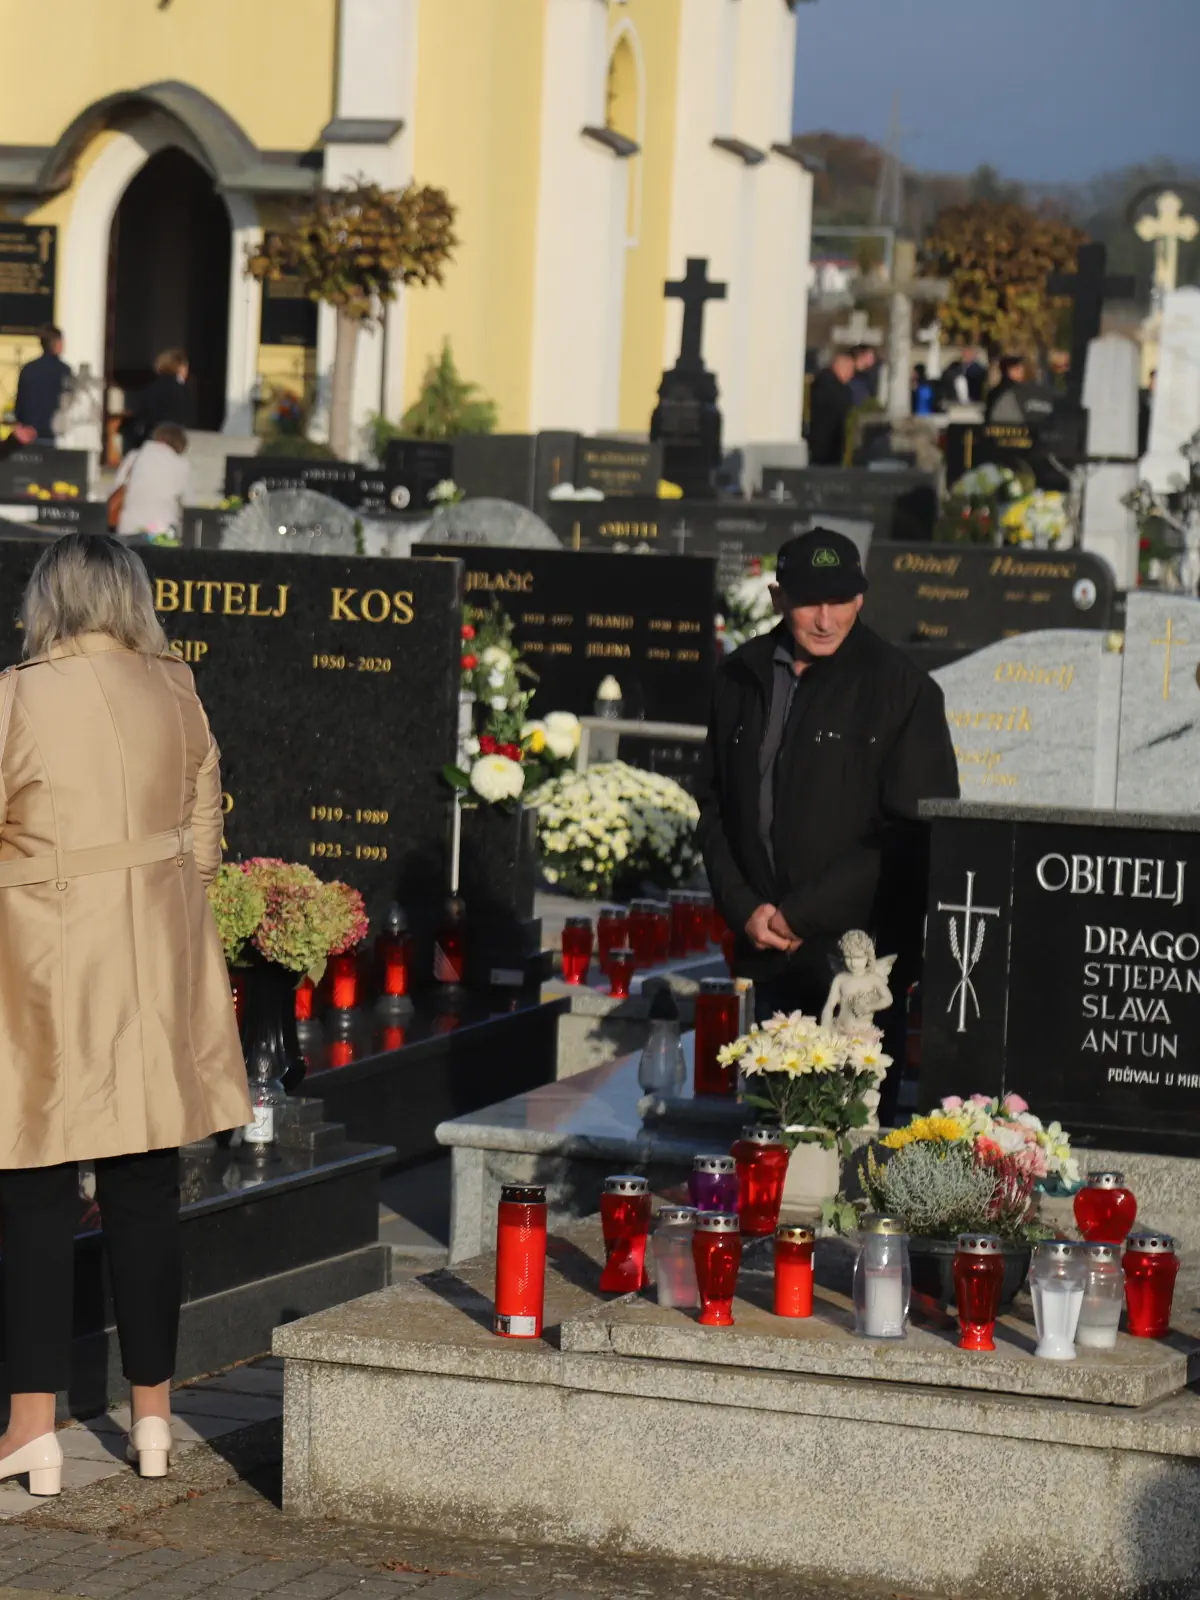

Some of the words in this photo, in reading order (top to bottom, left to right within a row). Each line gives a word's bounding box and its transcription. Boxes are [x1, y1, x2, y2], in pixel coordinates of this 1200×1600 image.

[330, 587, 415, 625] KOS
[357, 656, 392, 672] 2020
[310, 806, 343, 822] 1919
[355, 809, 389, 825] 1989
[1036, 853, 1187, 906] OBITELJ
[1084, 924, 1200, 963] DRAGO
[1082, 994, 1171, 1025] SLAVA
[1081, 1028, 1178, 1059] ANTUN
[1108, 1066, 1159, 1084] POČIVALI
[1165, 1072, 1174, 1086] U
[1178, 1073, 1200, 1089] MIR
